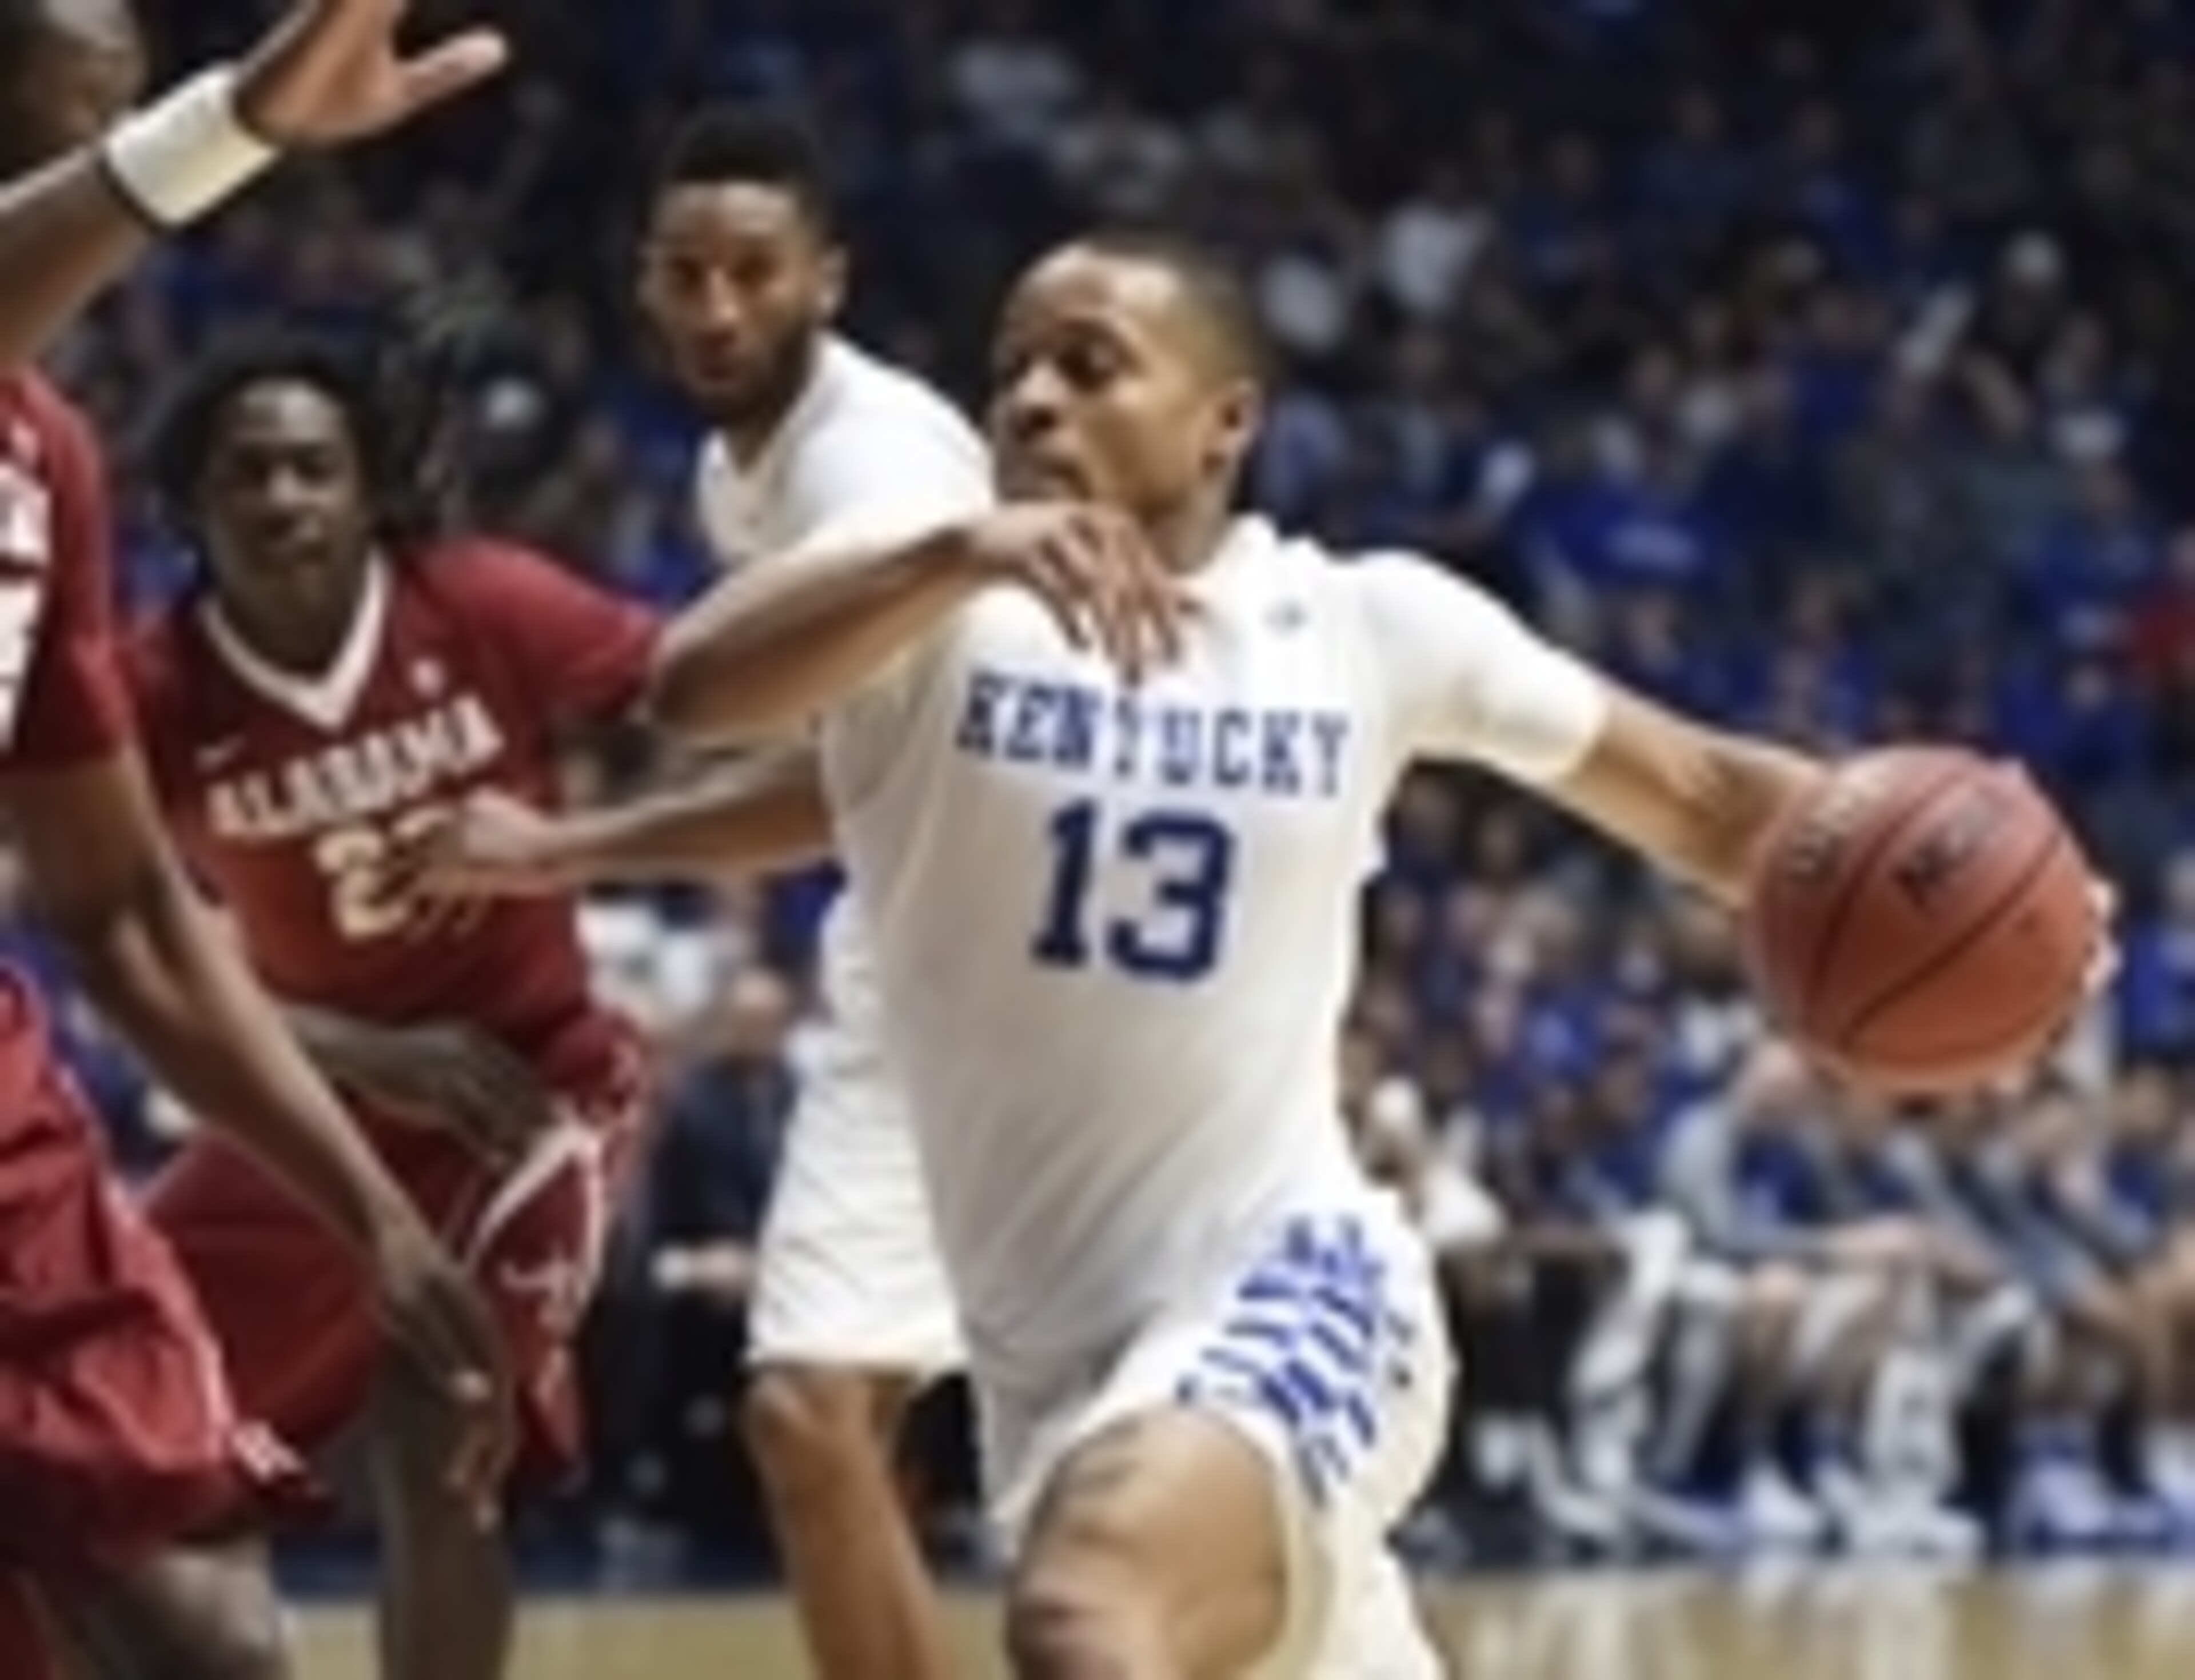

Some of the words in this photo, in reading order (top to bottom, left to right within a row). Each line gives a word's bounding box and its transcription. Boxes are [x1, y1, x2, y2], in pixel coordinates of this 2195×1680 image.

[207, 693, 504, 838] ALABAMA
[955, 666, 1350, 797] KENTUCKY
[1032, 795, 1236, 983] 13
